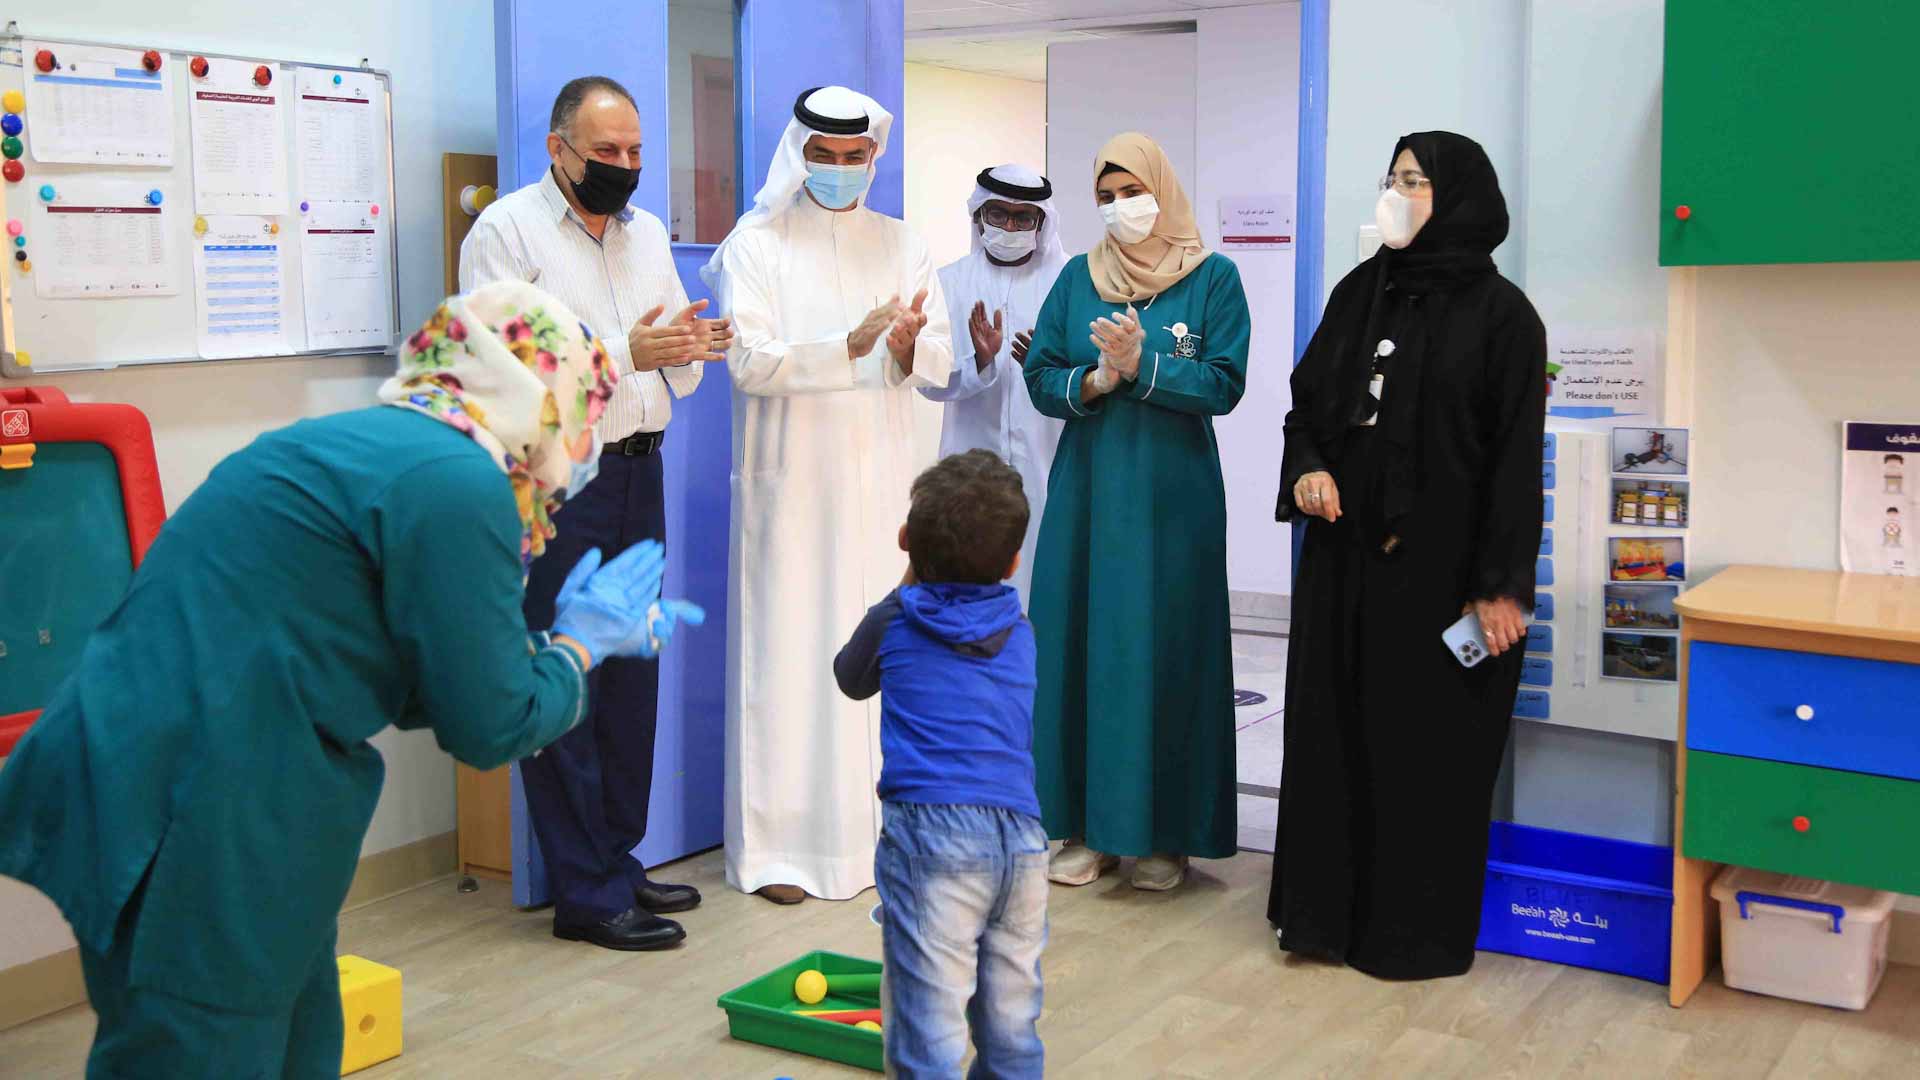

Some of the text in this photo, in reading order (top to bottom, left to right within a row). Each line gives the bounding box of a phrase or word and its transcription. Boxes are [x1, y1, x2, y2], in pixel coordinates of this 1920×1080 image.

[1566, 391, 1640, 400] Please don't USE
